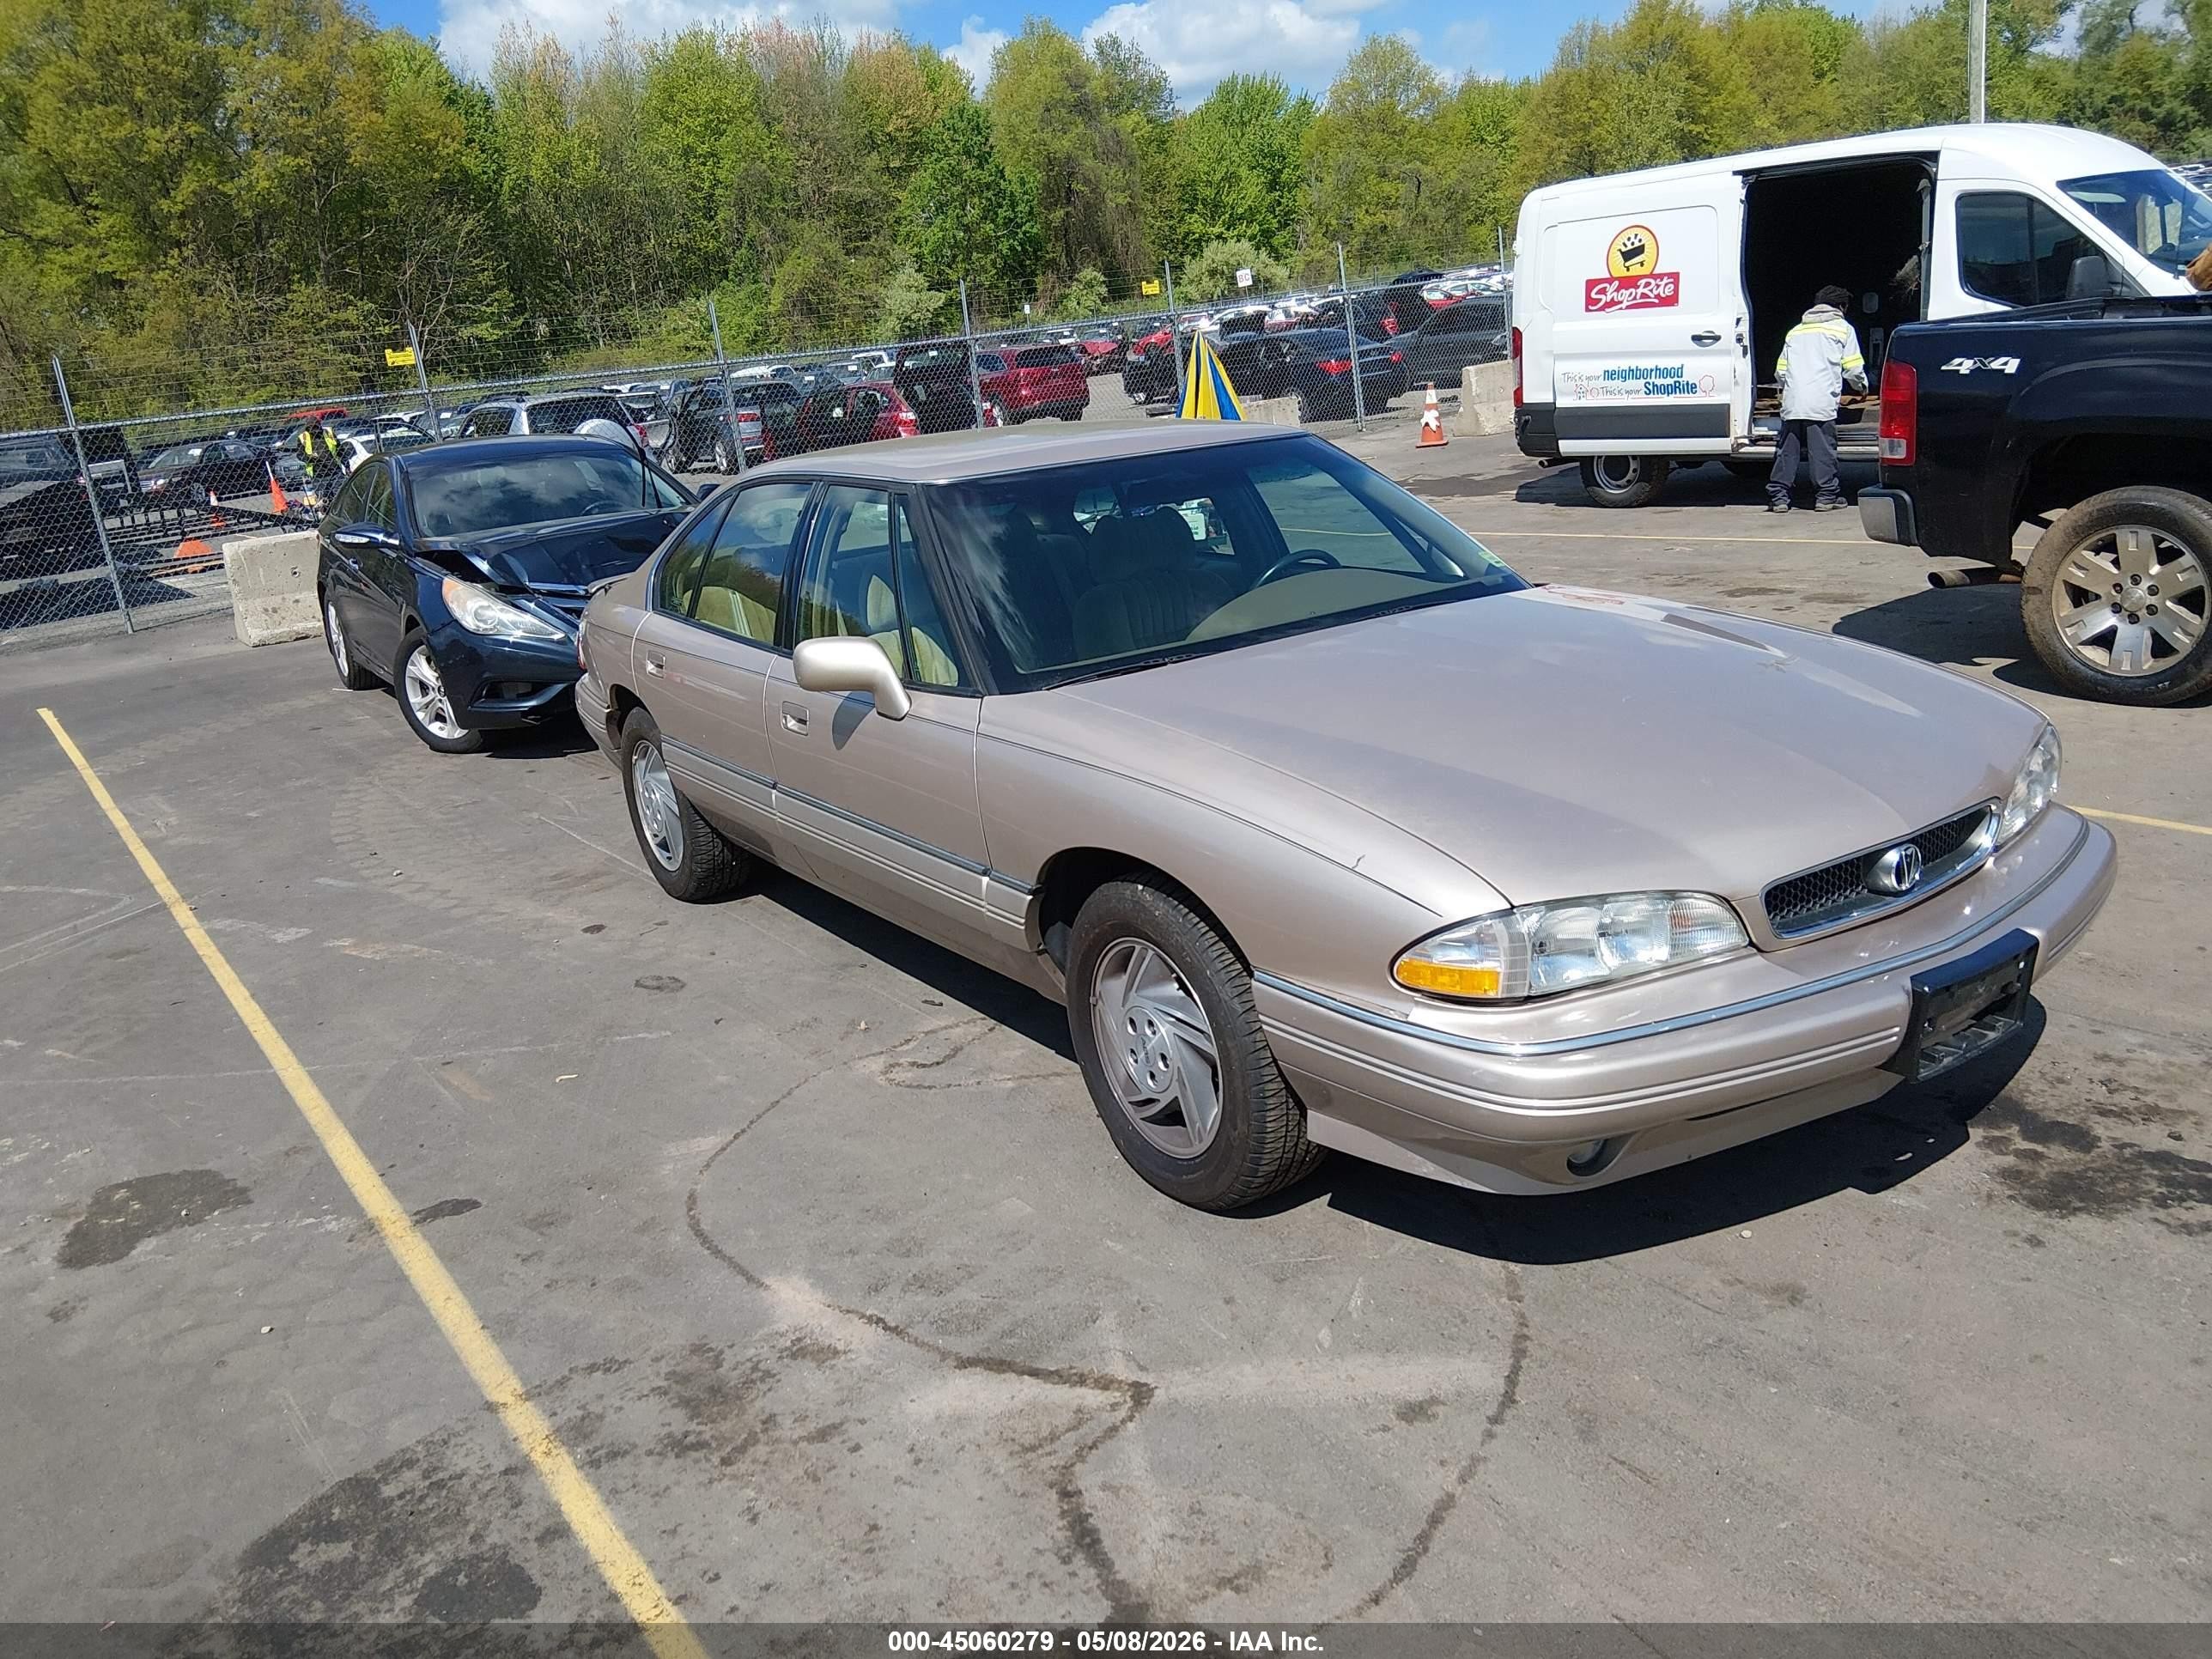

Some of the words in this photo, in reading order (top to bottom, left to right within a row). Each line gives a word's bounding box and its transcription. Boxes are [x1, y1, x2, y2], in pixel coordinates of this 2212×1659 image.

[1589, 276, 1674, 310] ShopRite
[1561, 372, 1577, 383] This
[1585, 374, 1602, 386] your
[1603, 364, 1684, 382] neighborhood
[1600, 386, 1616, 397] This
[1617, 386, 1624, 397] is
[1624, 388, 1643, 401] your
[1644, 380, 1698, 397] ShopRite
